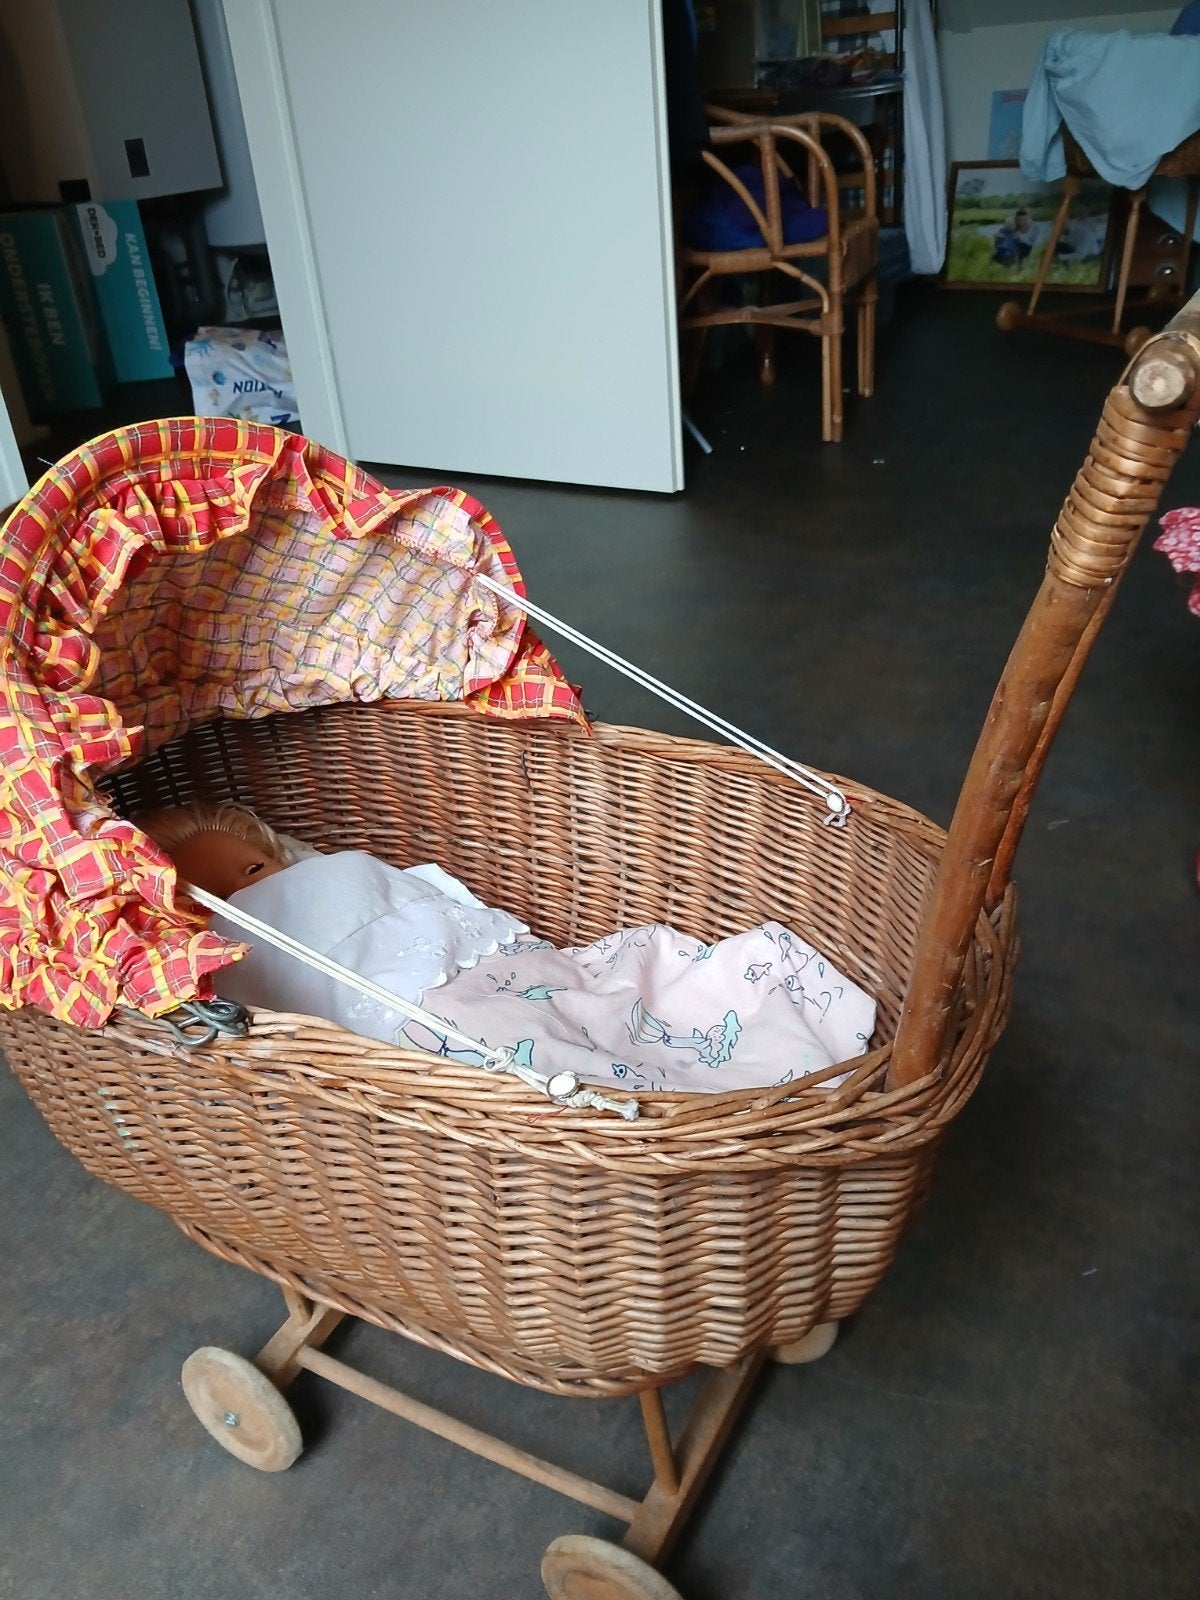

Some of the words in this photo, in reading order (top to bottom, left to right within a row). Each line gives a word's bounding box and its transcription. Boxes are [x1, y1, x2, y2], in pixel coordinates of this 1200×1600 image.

[124, 232, 142, 268] KAN
[37, 283, 54, 304] IK
[131, 266, 162, 351] BEGINNEN!
[45, 305, 65, 346] BEN
[233, 380, 283, 399] ATION
